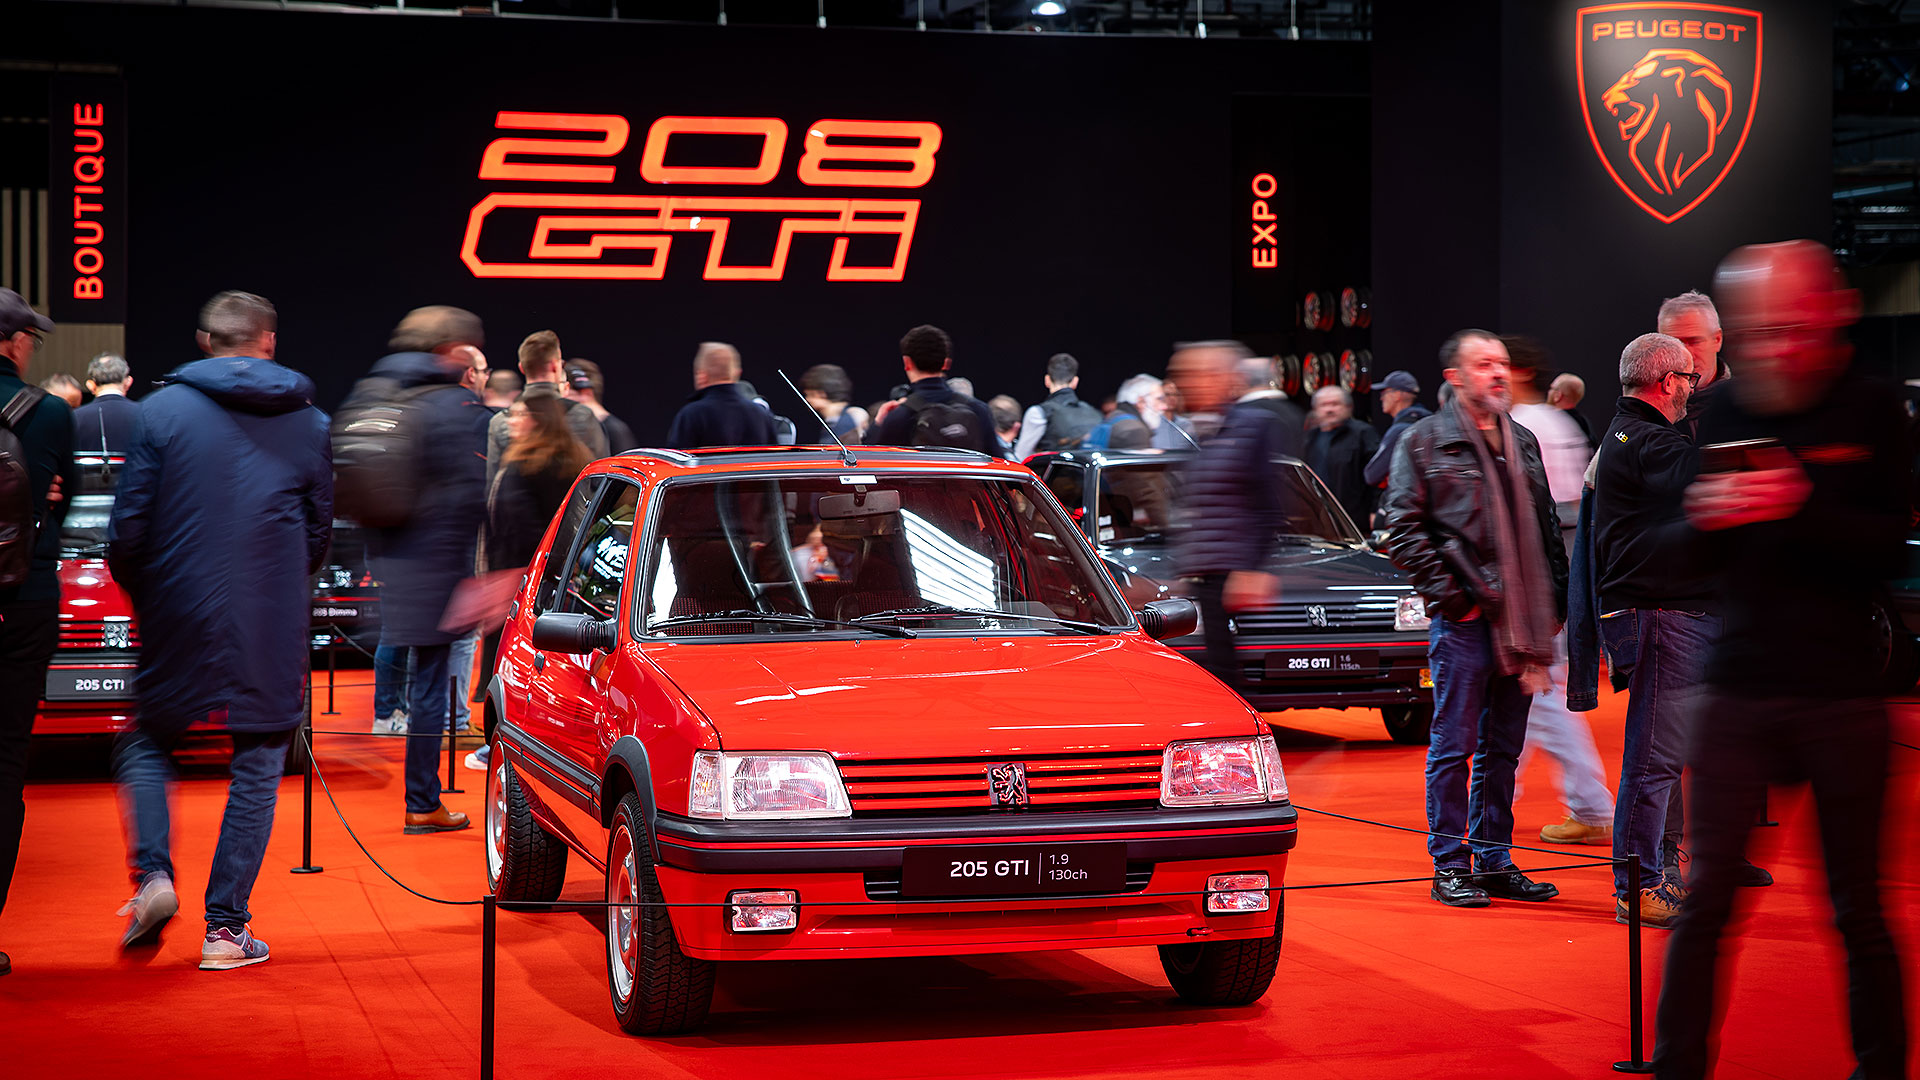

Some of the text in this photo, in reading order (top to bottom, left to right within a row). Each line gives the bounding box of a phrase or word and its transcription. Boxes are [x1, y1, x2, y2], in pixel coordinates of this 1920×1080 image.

[1592, 19, 1747, 42] PEUGEOT
[478, 110, 943, 189] 208
[73, 102, 105, 300] BOUTIQUE
[1251, 172, 1278, 268] EXPO
[1288, 658, 1330, 669] 205 GTI
[75, 679, 125, 691] 205 CTI
[950, 859, 1029, 878] 205 GTI
[1049, 853, 1069, 865] 1.9
[1048, 868, 1088, 880] 130ch
